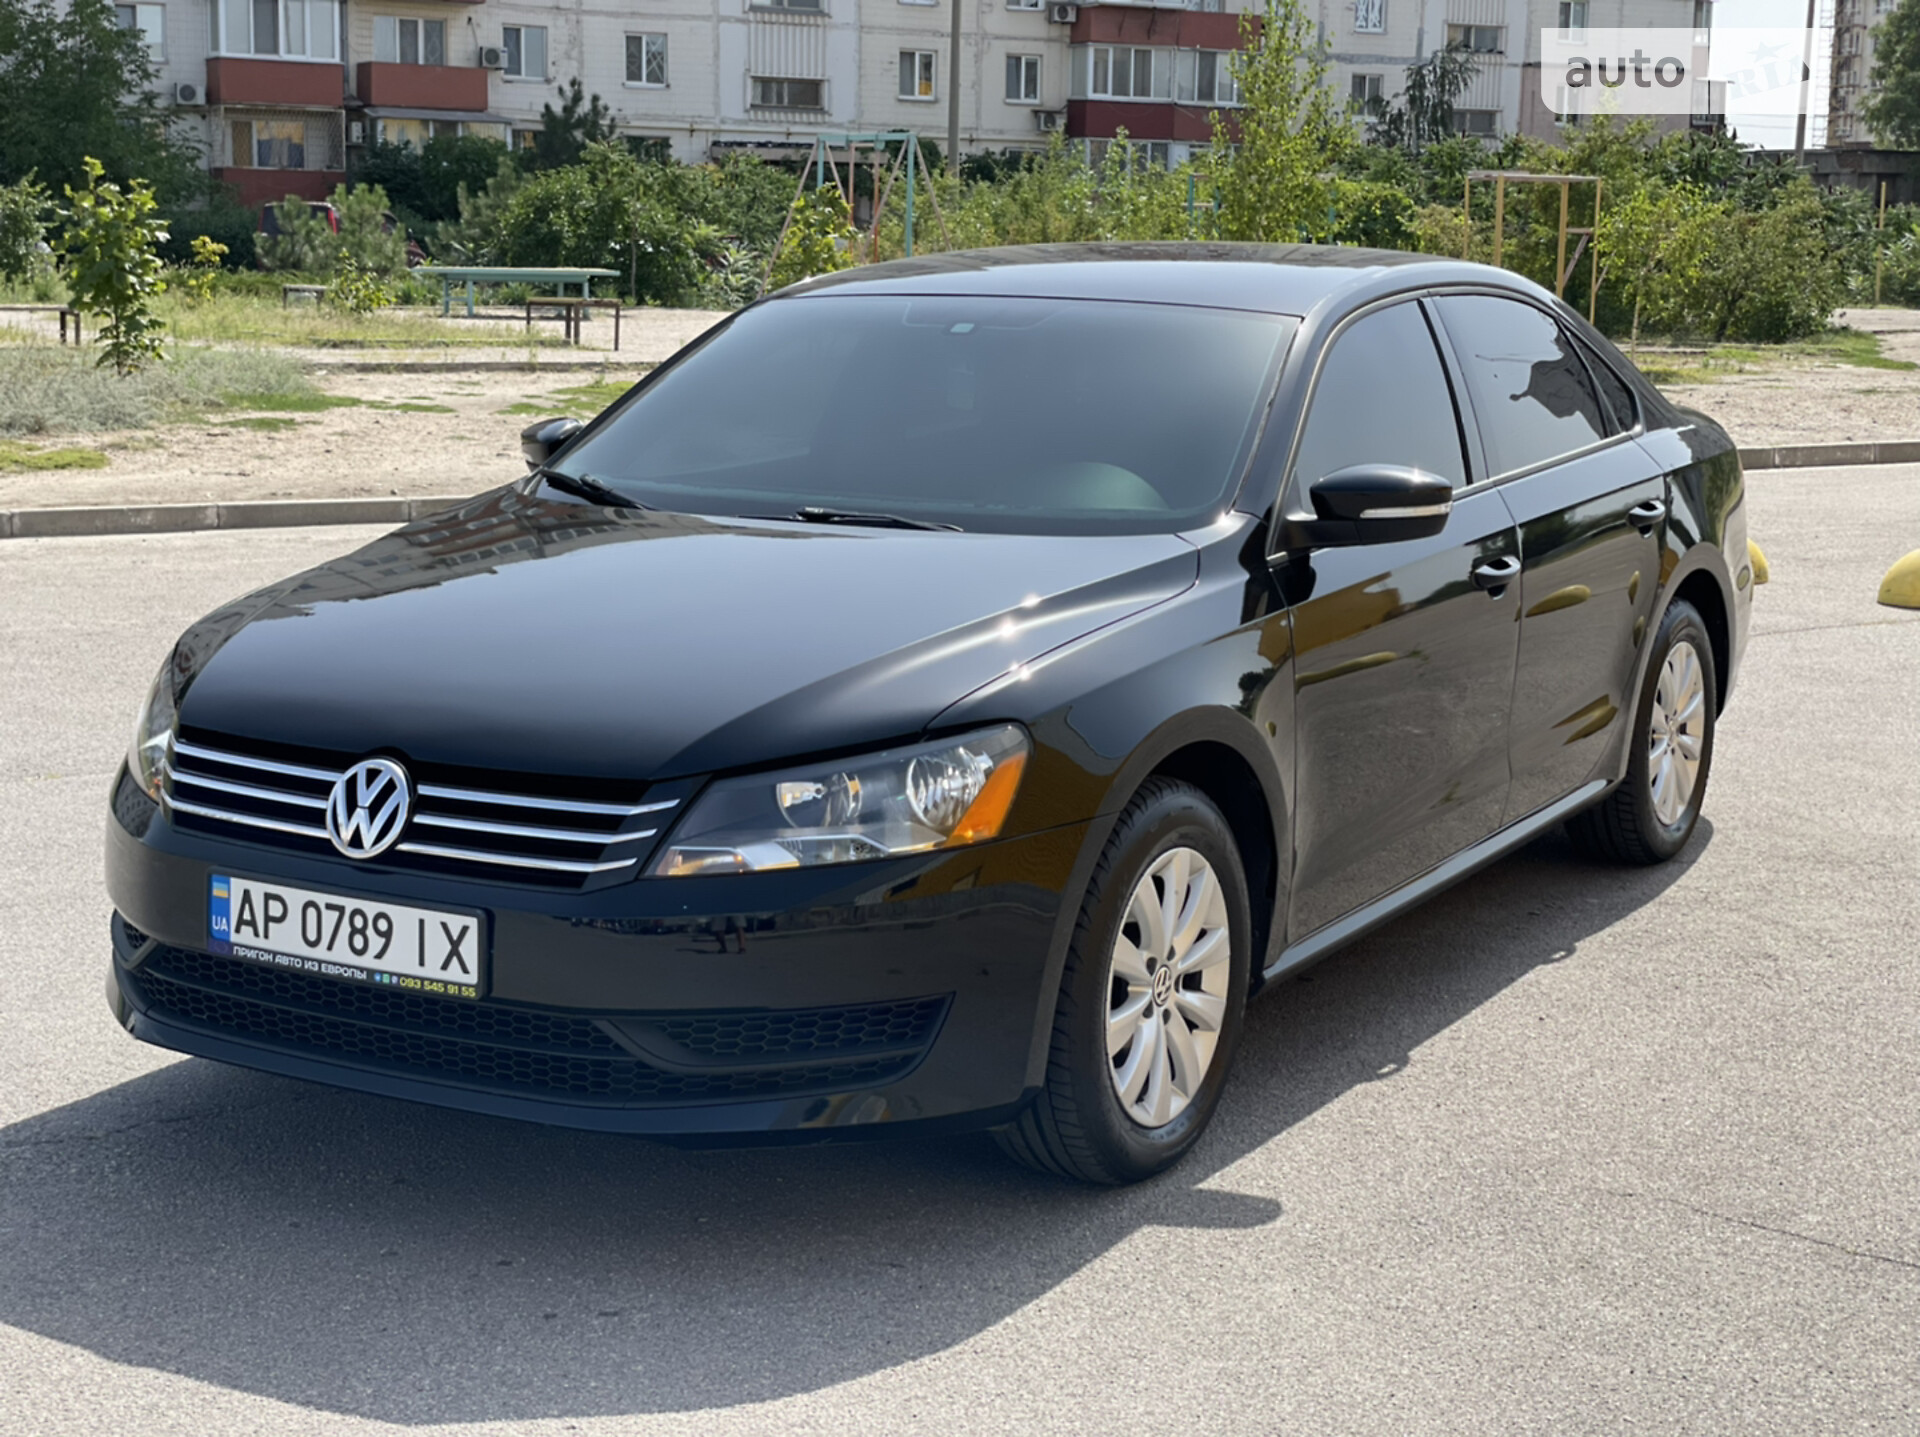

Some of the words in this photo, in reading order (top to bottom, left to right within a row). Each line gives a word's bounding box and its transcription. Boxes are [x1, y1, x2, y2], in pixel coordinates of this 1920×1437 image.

[331, 760, 406, 856] VW
[212, 915, 229, 932] UA
[234, 888, 289, 940] AP
[301, 899, 394, 960] 0789
[232, 945, 274, 963] ПРИГОН
[275, 954, 302, 968] АВТО
[304, 960, 319, 971] ИЗ
[321, 963, 368, 980] ЕВРОПЫ
[400, 976, 421, 989] 093
[423, 979, 445, 993] 545
[447, 984, 459, 994] 91
[461, 986, 476, 997] 55
